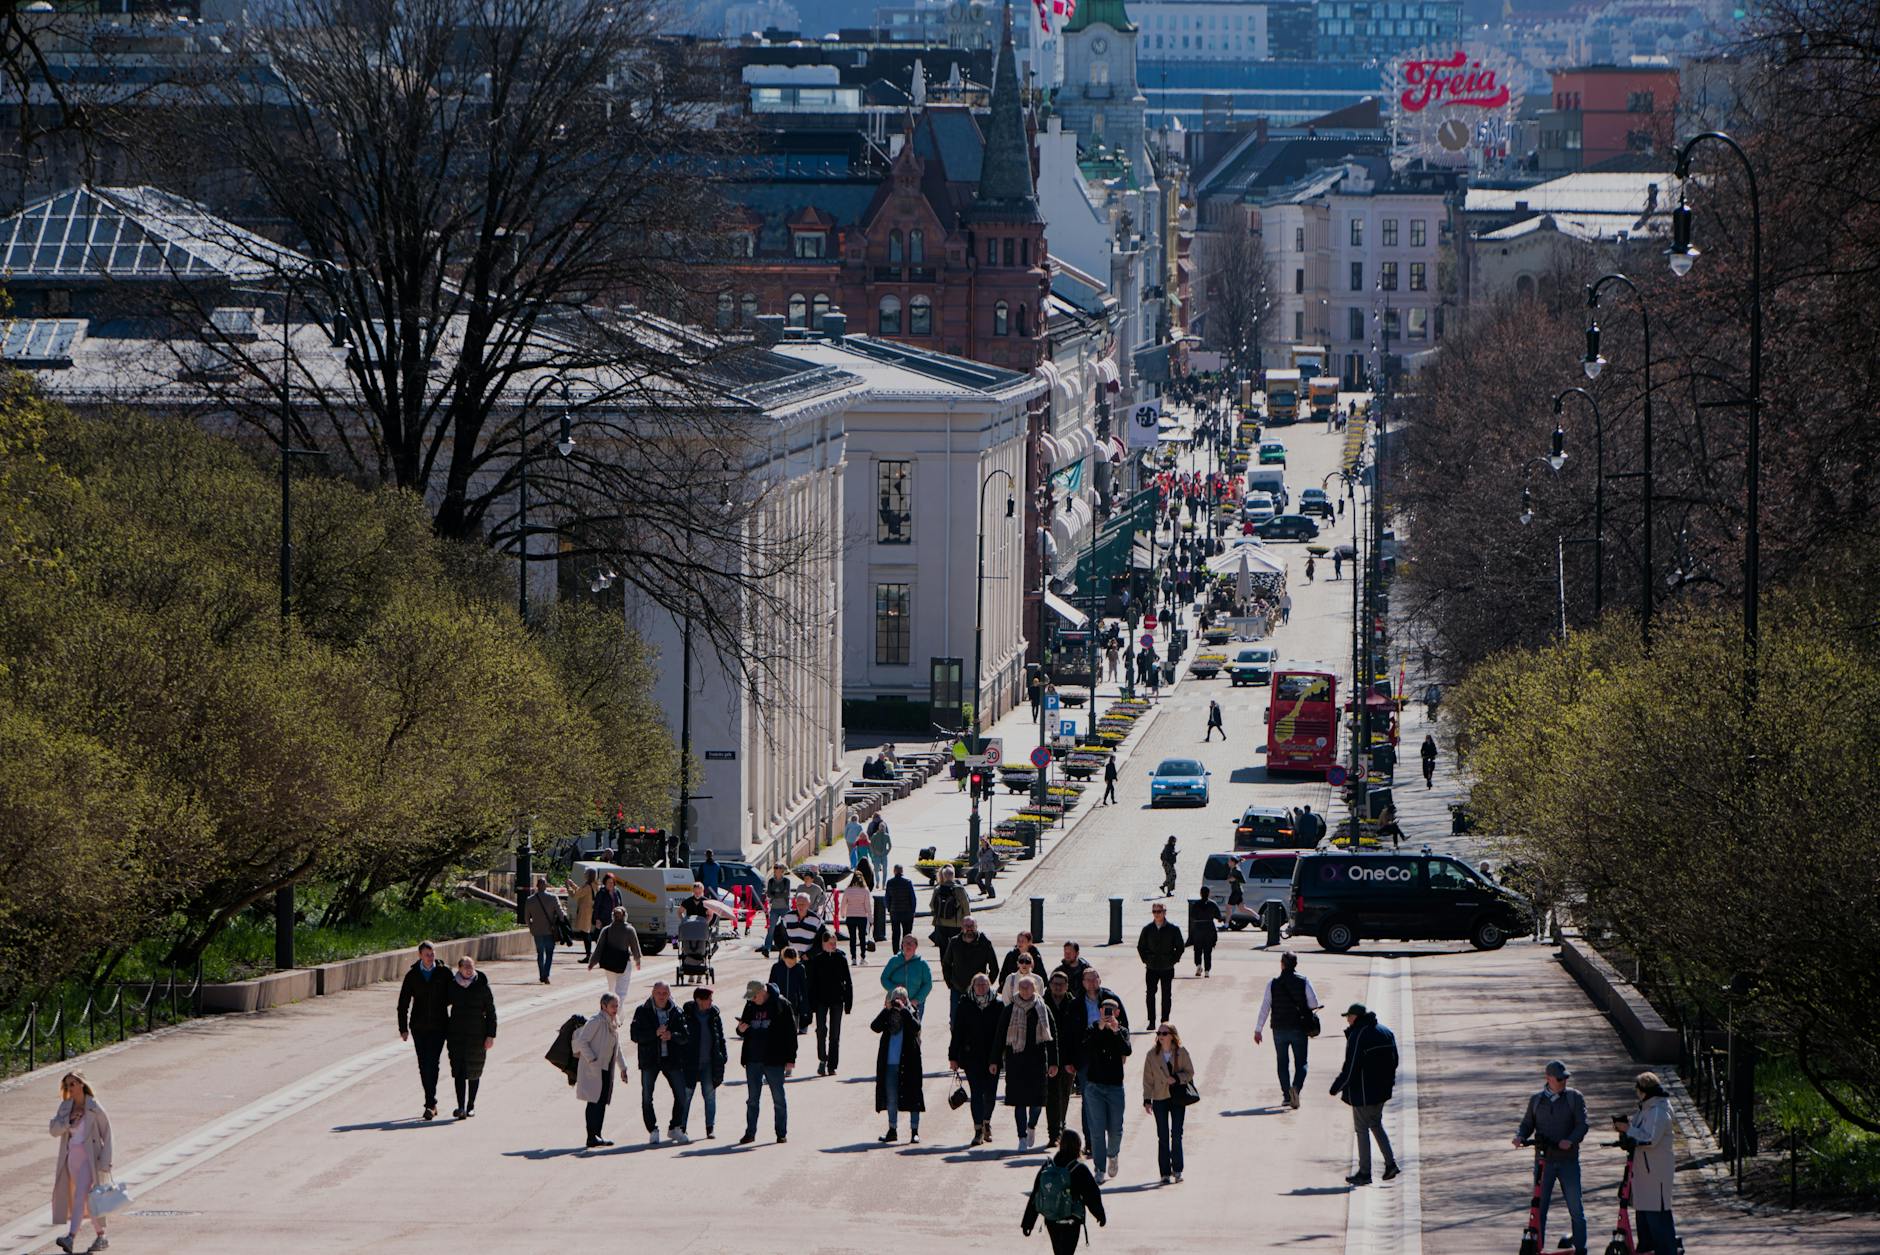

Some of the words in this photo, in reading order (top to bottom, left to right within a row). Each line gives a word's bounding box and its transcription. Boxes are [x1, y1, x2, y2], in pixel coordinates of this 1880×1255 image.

[1401, 51, 1509, 112] Freia
[987, 751, 997, 760] 30
[1348, 865, 1412, 882] OneCo
